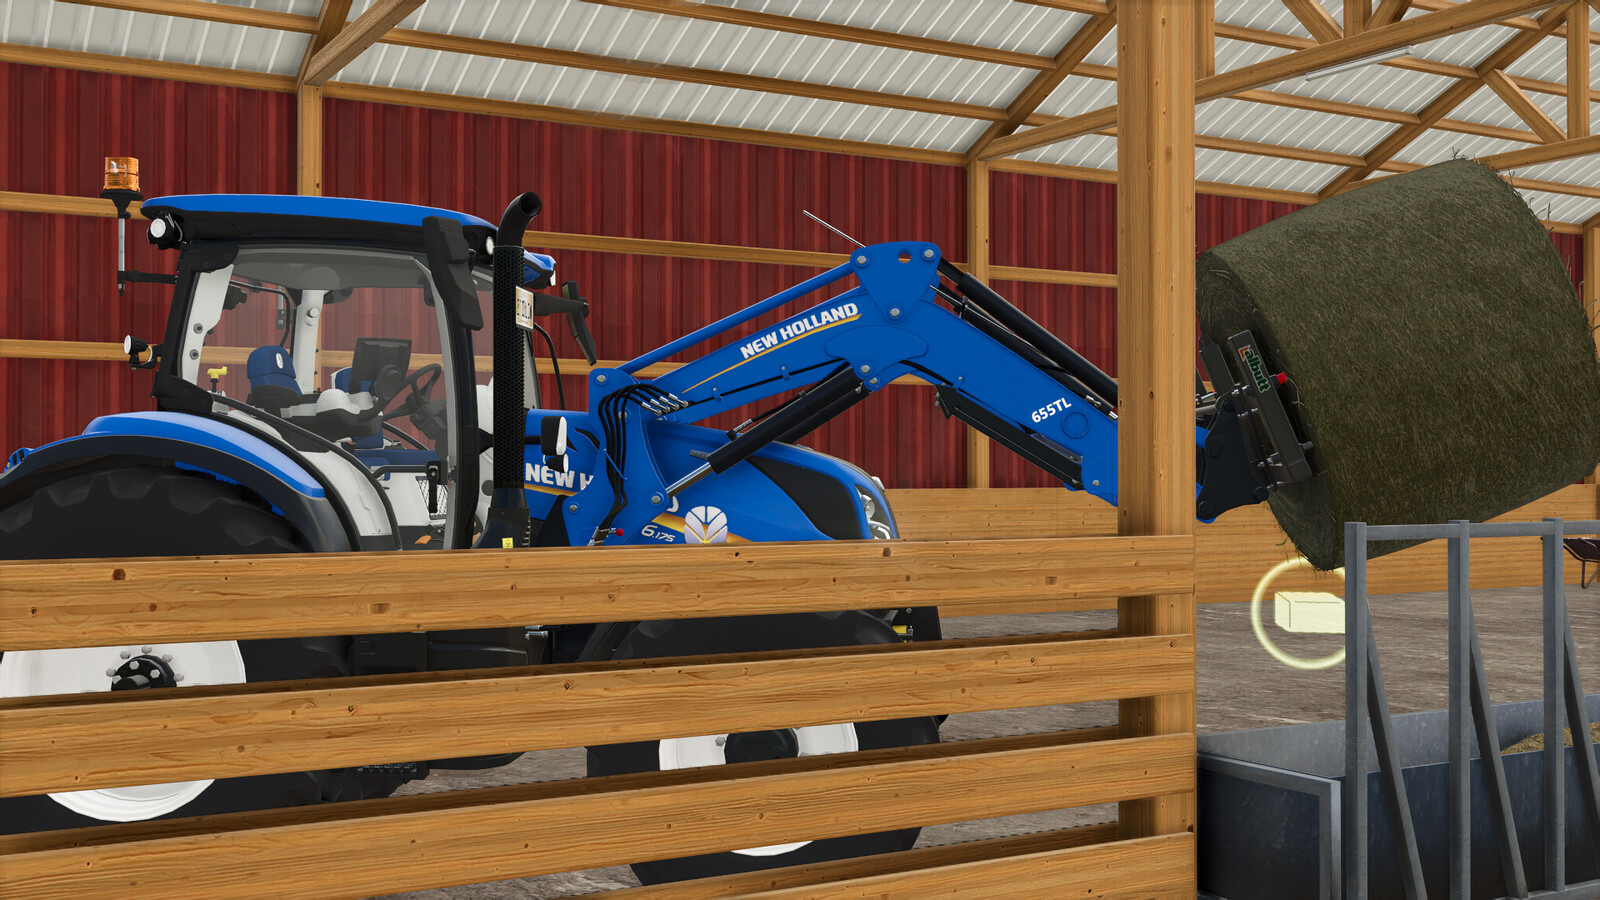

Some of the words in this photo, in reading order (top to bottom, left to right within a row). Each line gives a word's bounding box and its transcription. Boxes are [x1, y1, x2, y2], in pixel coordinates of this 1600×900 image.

[740, 331, 778, 359] NEW
[779, 302, 859, 340] HOLLAND
[1243, 348, 1271, 393] albutt
[1031, 397, 1072, 423] 655TL
[525, 463, 575, 489] NEW
[641, 524, 676, 543] 6.175
